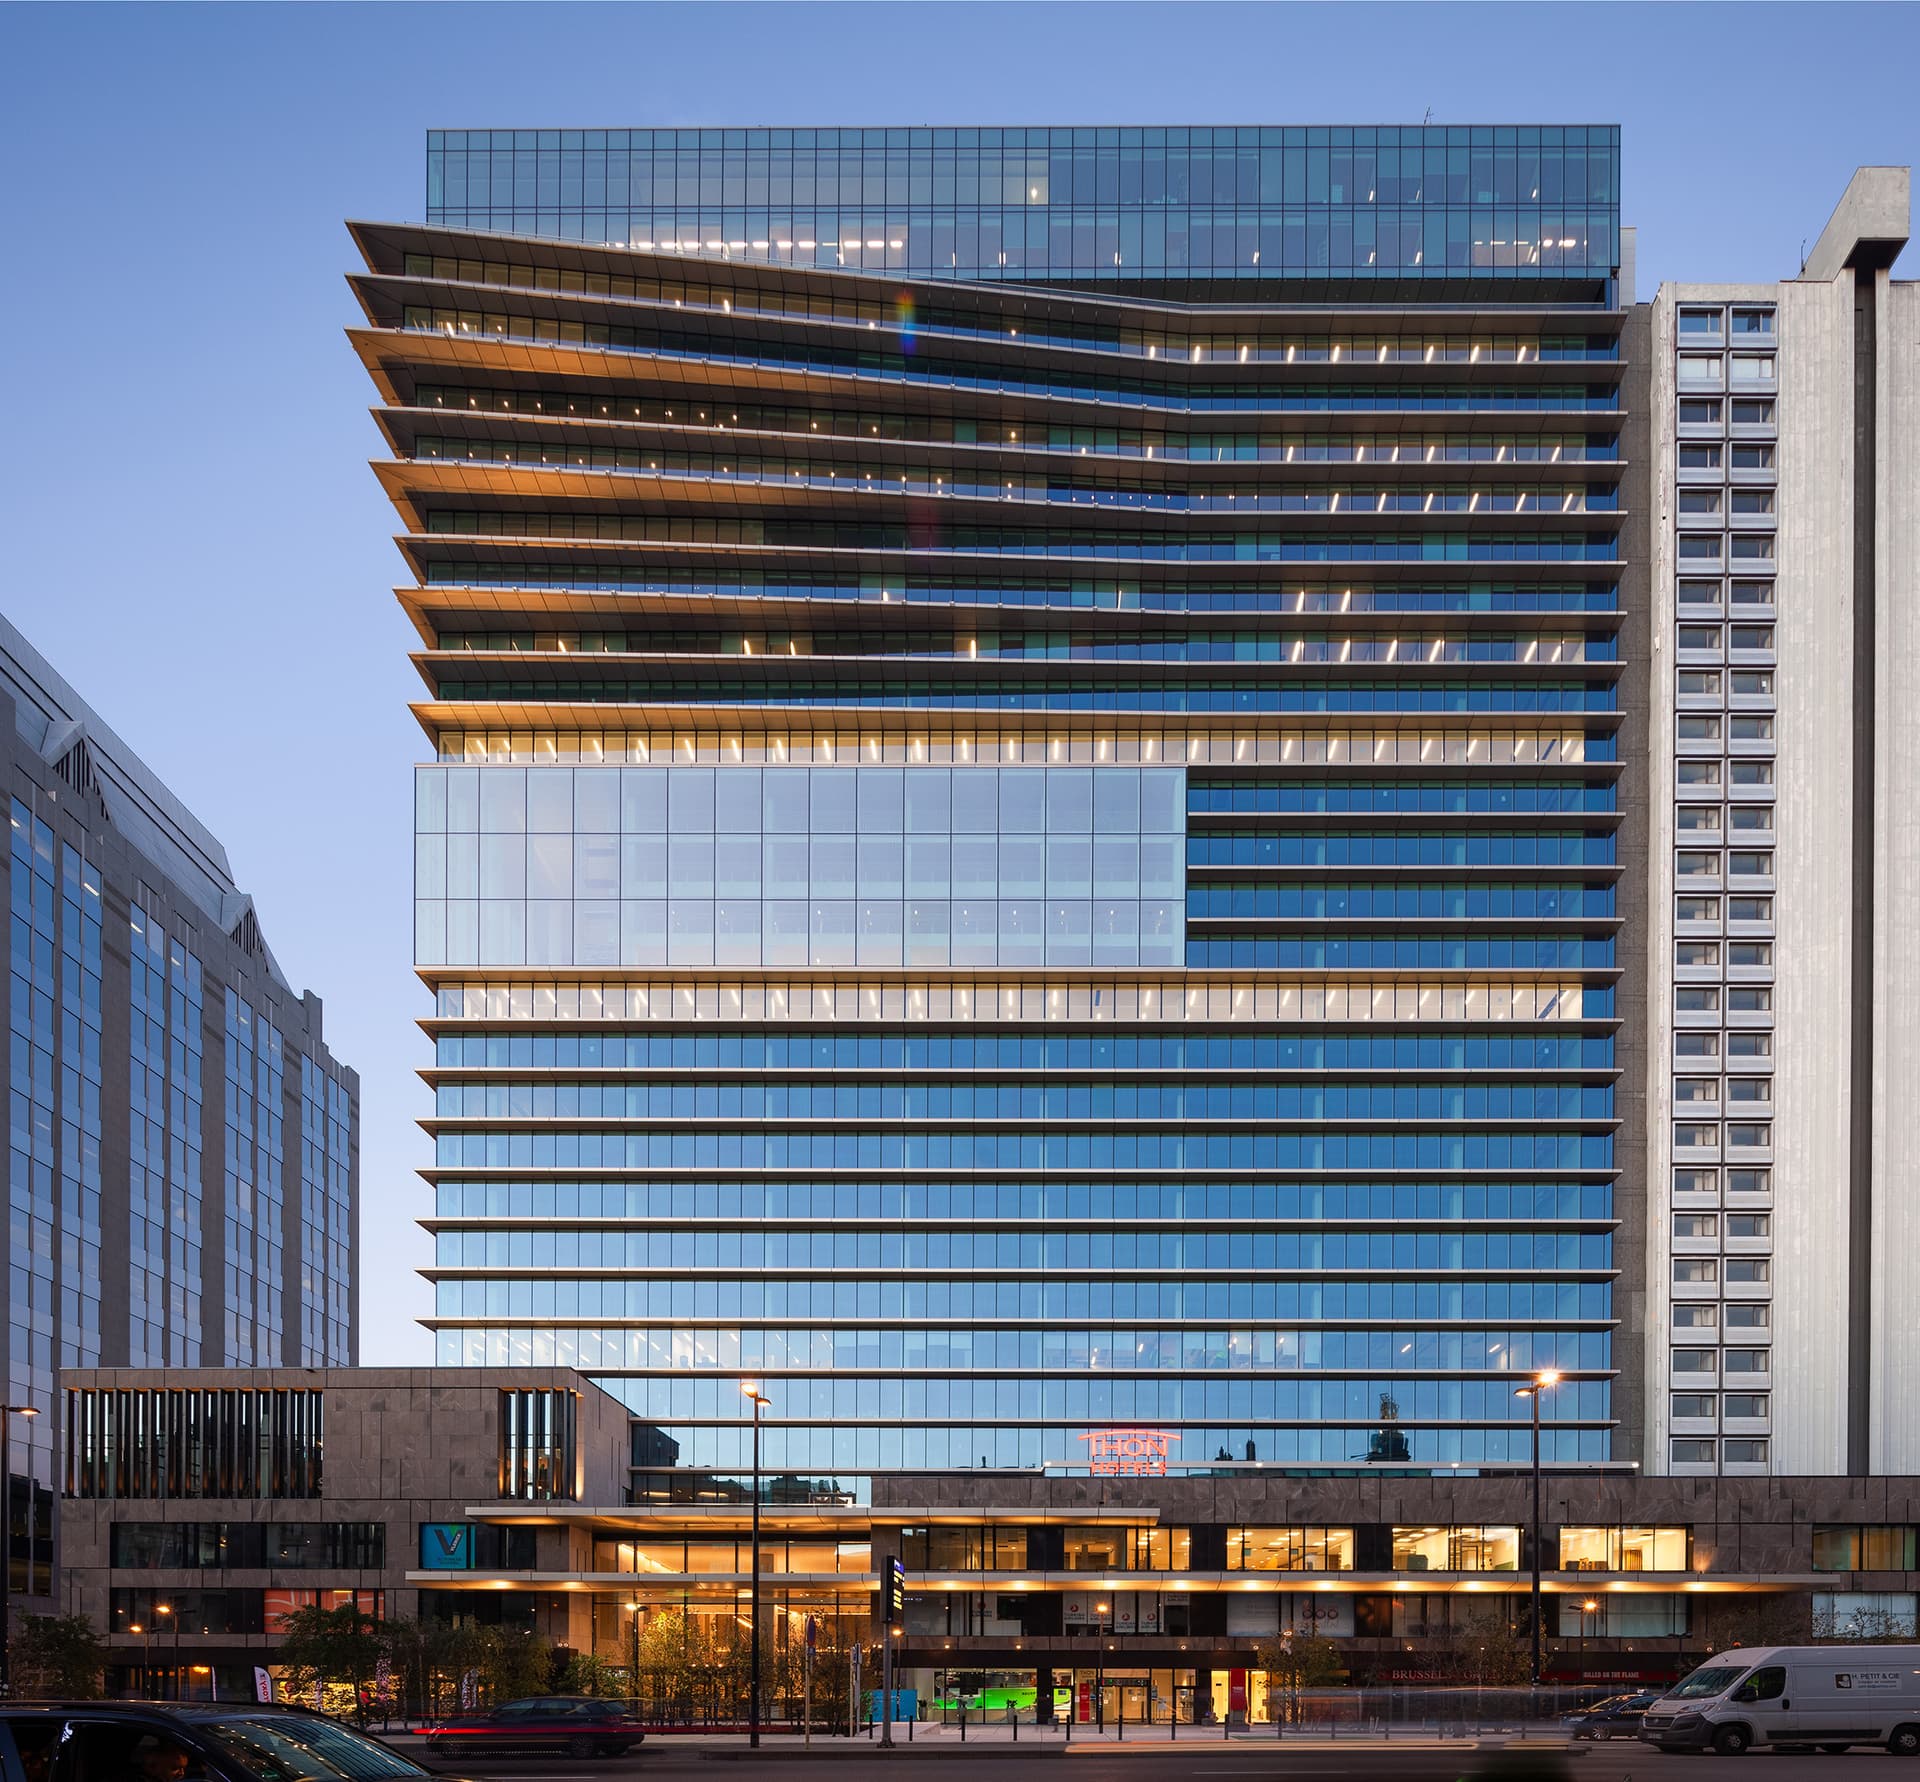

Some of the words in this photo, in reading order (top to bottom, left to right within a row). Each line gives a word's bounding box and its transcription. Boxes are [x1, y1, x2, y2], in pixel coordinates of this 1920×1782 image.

[1078, 1430, 1181, 1457] THON
[1091, 1461, 1167, 1475] HOTELS
[1860, 1672, 1881, 1680] PETIT
